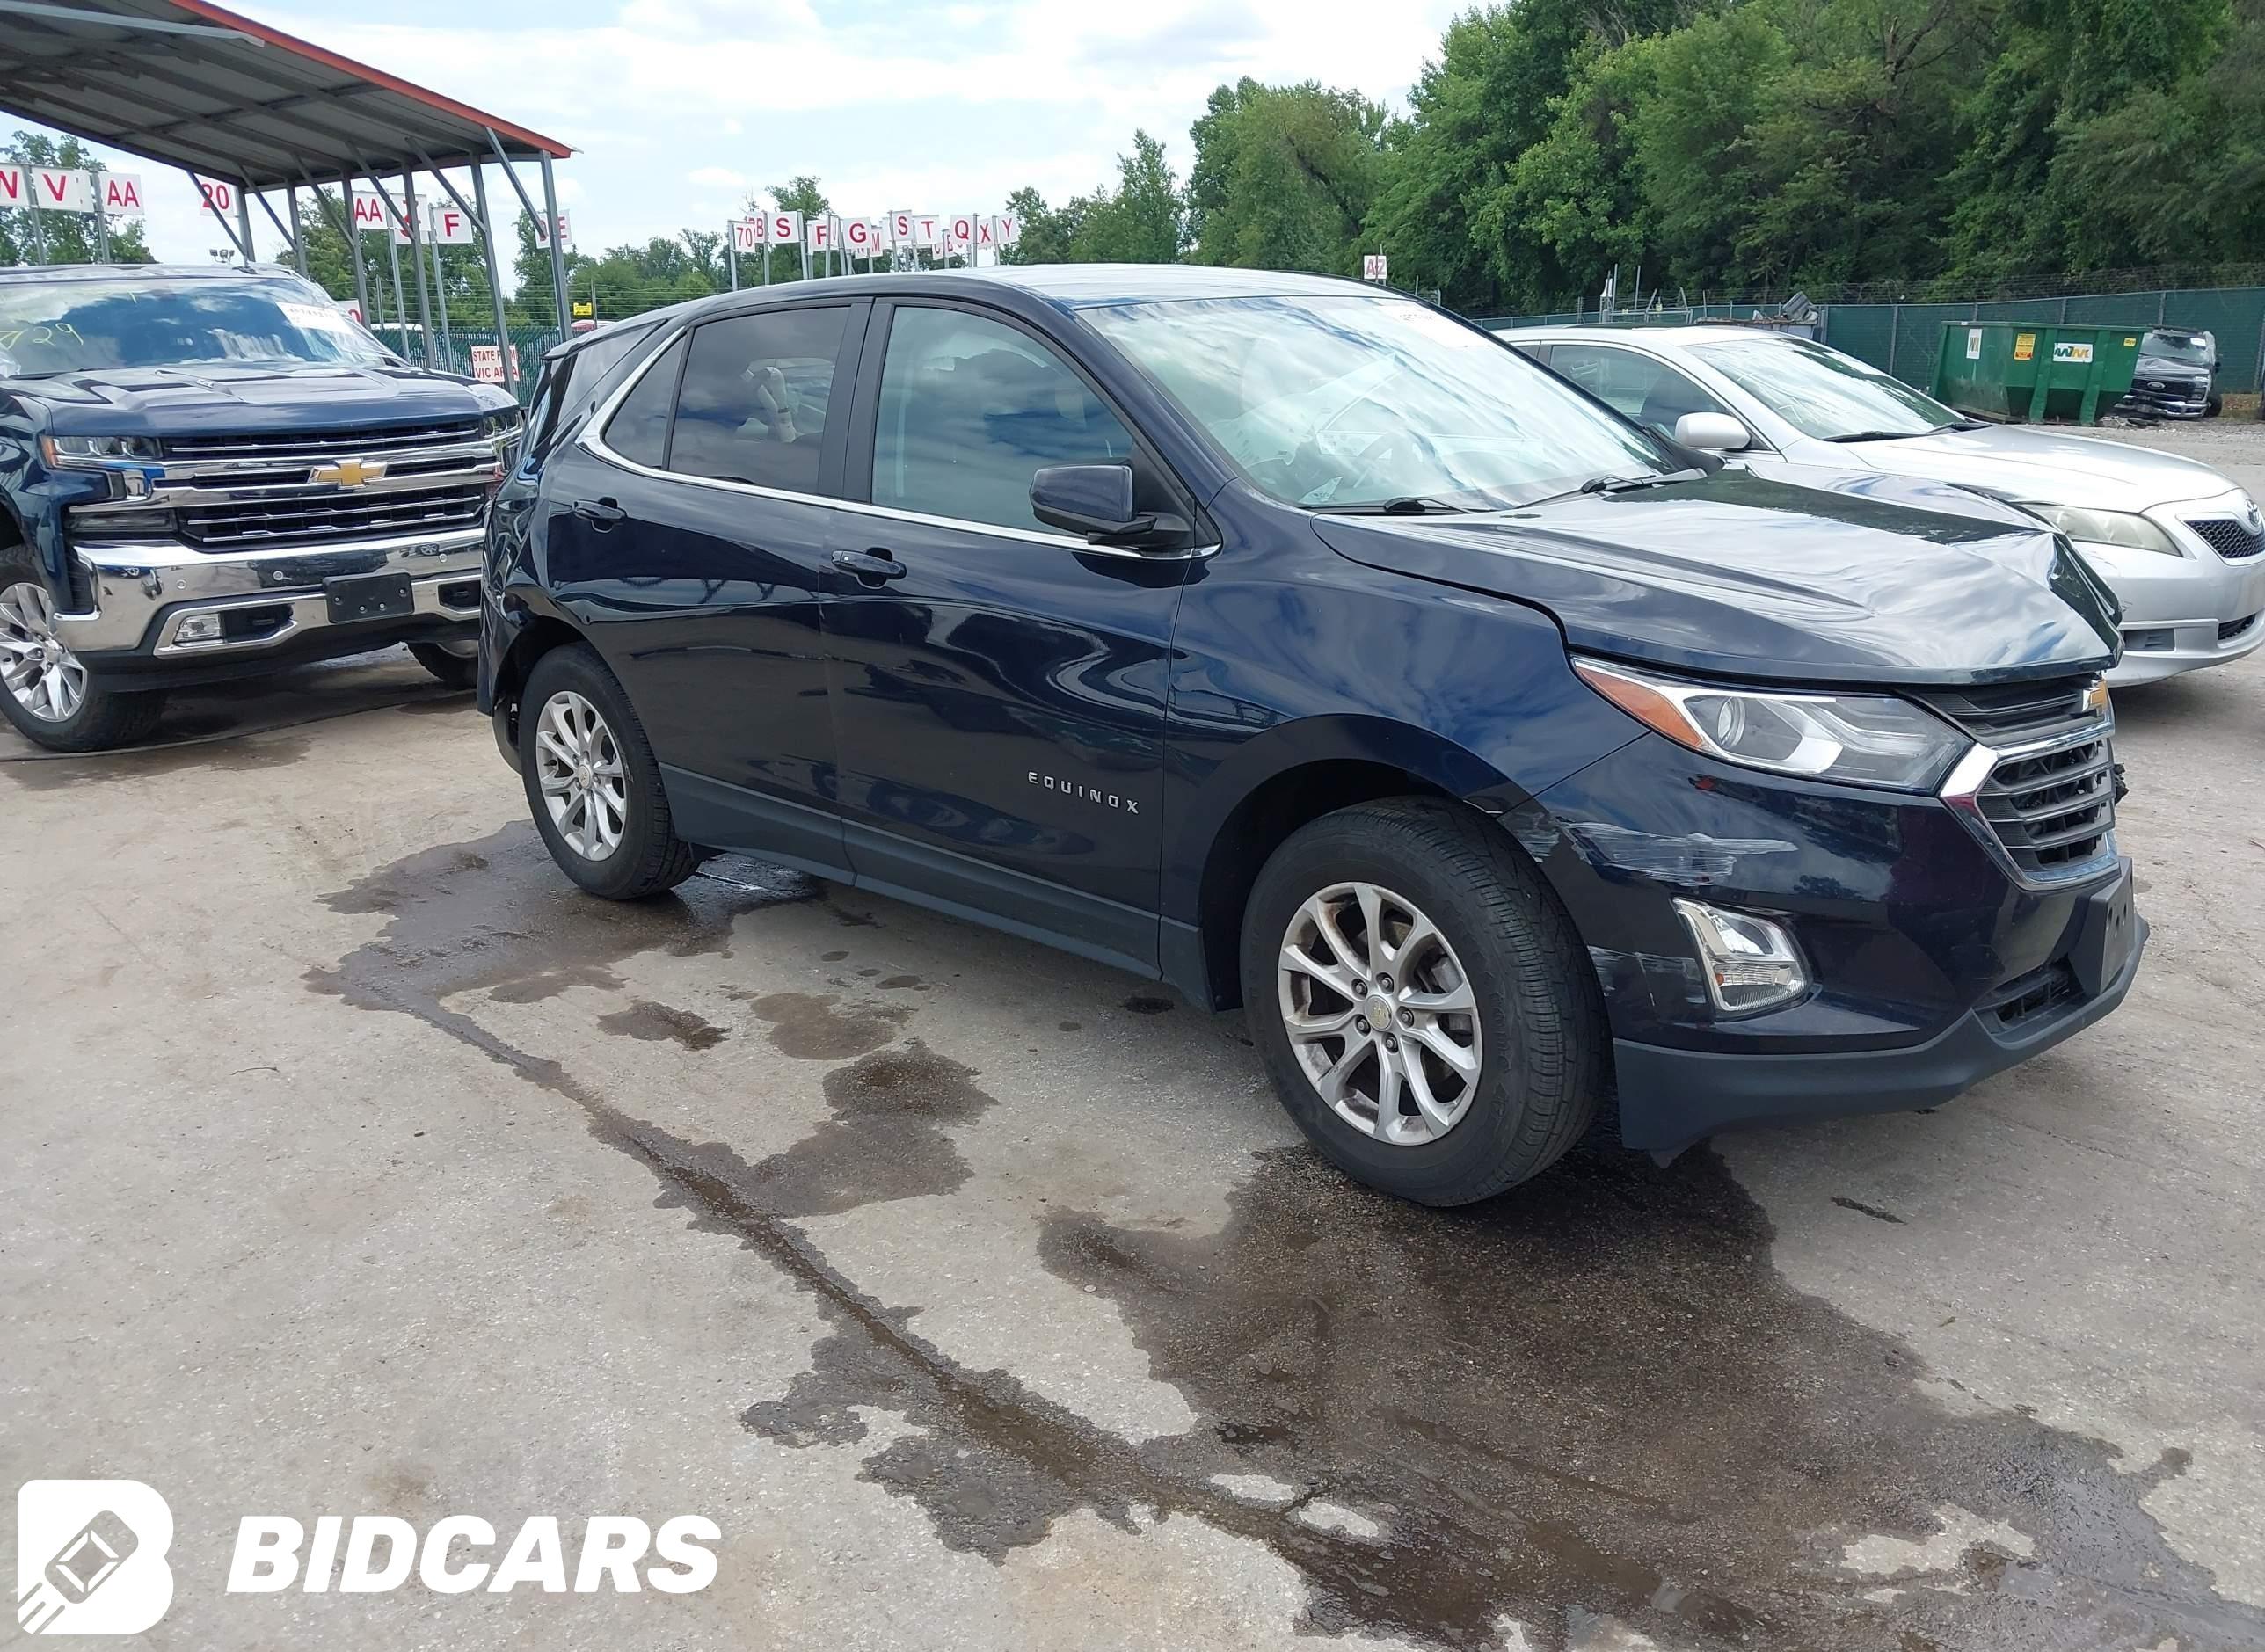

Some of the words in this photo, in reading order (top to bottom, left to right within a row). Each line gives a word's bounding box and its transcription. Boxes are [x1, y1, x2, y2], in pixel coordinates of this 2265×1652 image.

[42, 174, 66, 201] V
[107, 180, 139, 207] AA
[355, 198, 382, 222] AA
[444, 214, 459, 237] F
[776, 217, 791, 237] S
[816, 225, 827, 244] F
[849, 222, 867, 243] G
[898, 216, 908, 236] S
[921, 221, 934, 239] T
[955, 220, 969, 239] Q
[980, 223, 991, 243] X
[1002, 217, 1012, 237] Y
[736, 227, 753, 247] 70
[473, 350, 495, 361] STATE
[497, 349, 517, 360] FM
[476, 367, 492, 378] VIC
[494, 365, 518, 377] ARA
[1028, 771, 1140, 814] EQUINOX
